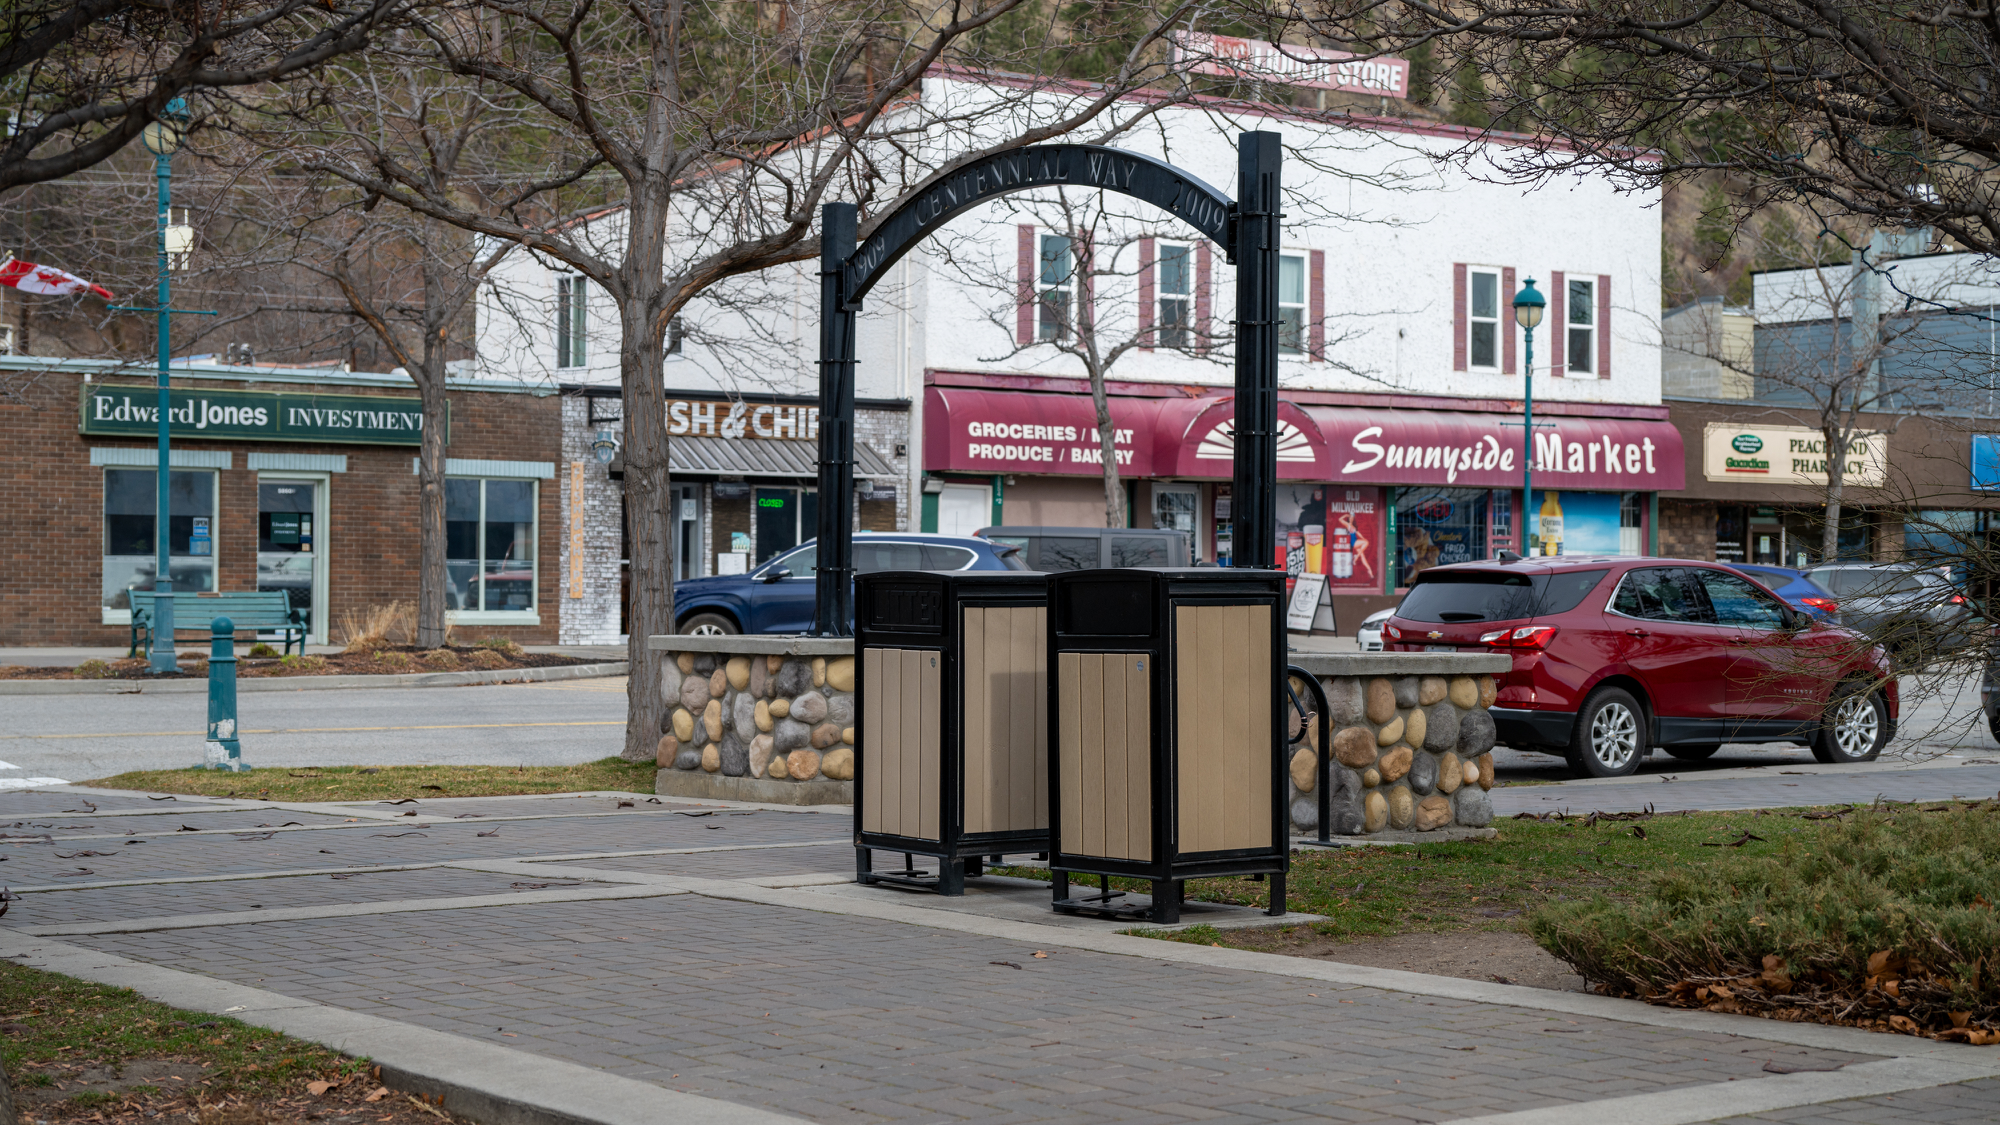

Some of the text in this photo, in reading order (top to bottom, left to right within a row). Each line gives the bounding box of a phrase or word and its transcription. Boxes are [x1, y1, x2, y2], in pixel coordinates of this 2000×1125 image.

[1337, 58, 1403, 92] STORE
[913, 151, 1227, 235] CENTENNIAL WAY 2009
[94, 396, 423, 431] Edward Jones INVESTMENT
[665, 401, 819, 439] SH & CHIP
[968, 422, 1134, 445] GROCERIES / MAT
[968, 443, 1134, 465] PRODUCE / BAKRY
[1341, 427, 1656, 484] Sunnyside Market
[1792, 459, 1863, 475] PHARCY
[759, 498, 784, 508] CLOSED
[1346, 490, 1360, 501] OLD
[1332, 502, 1374, 514] MILWAUKEE
[1417, 501, 1450, 517] OPEN
[573, 534, 581, 592] CHIPS
[1286, 546, 1305, 568] 1516
[873, 590, 942, 624] LITTER
